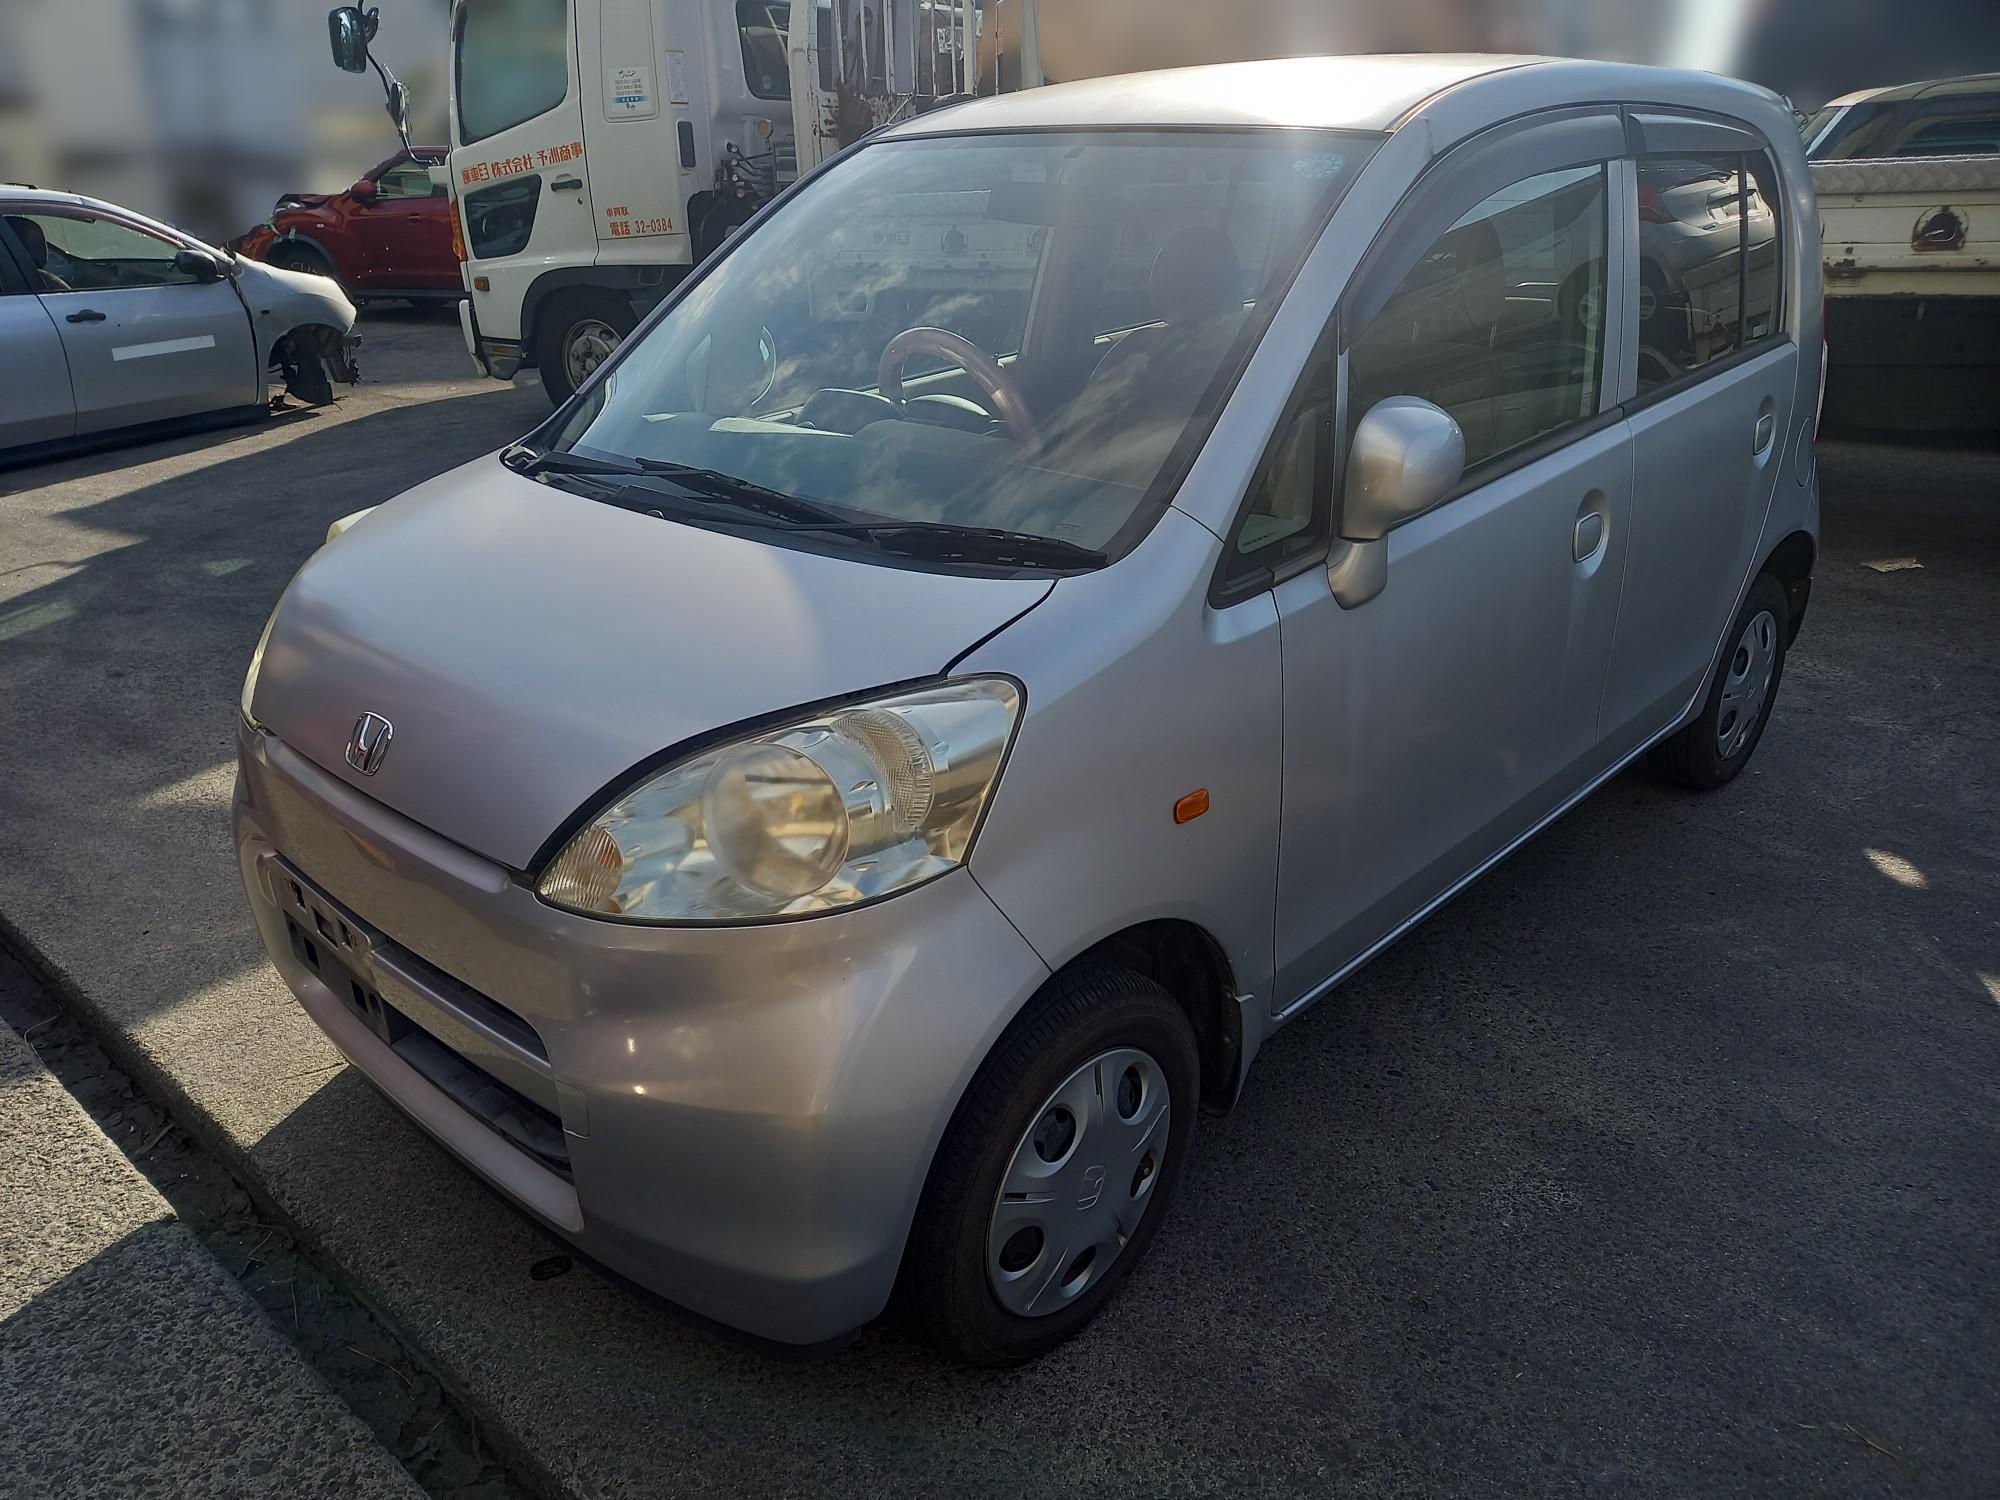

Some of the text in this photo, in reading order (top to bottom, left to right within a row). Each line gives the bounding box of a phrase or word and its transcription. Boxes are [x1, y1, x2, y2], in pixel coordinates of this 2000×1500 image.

[491, 154, 535, 178] 株式会社
[610, 217, 673, 237] 電話 32-0384
